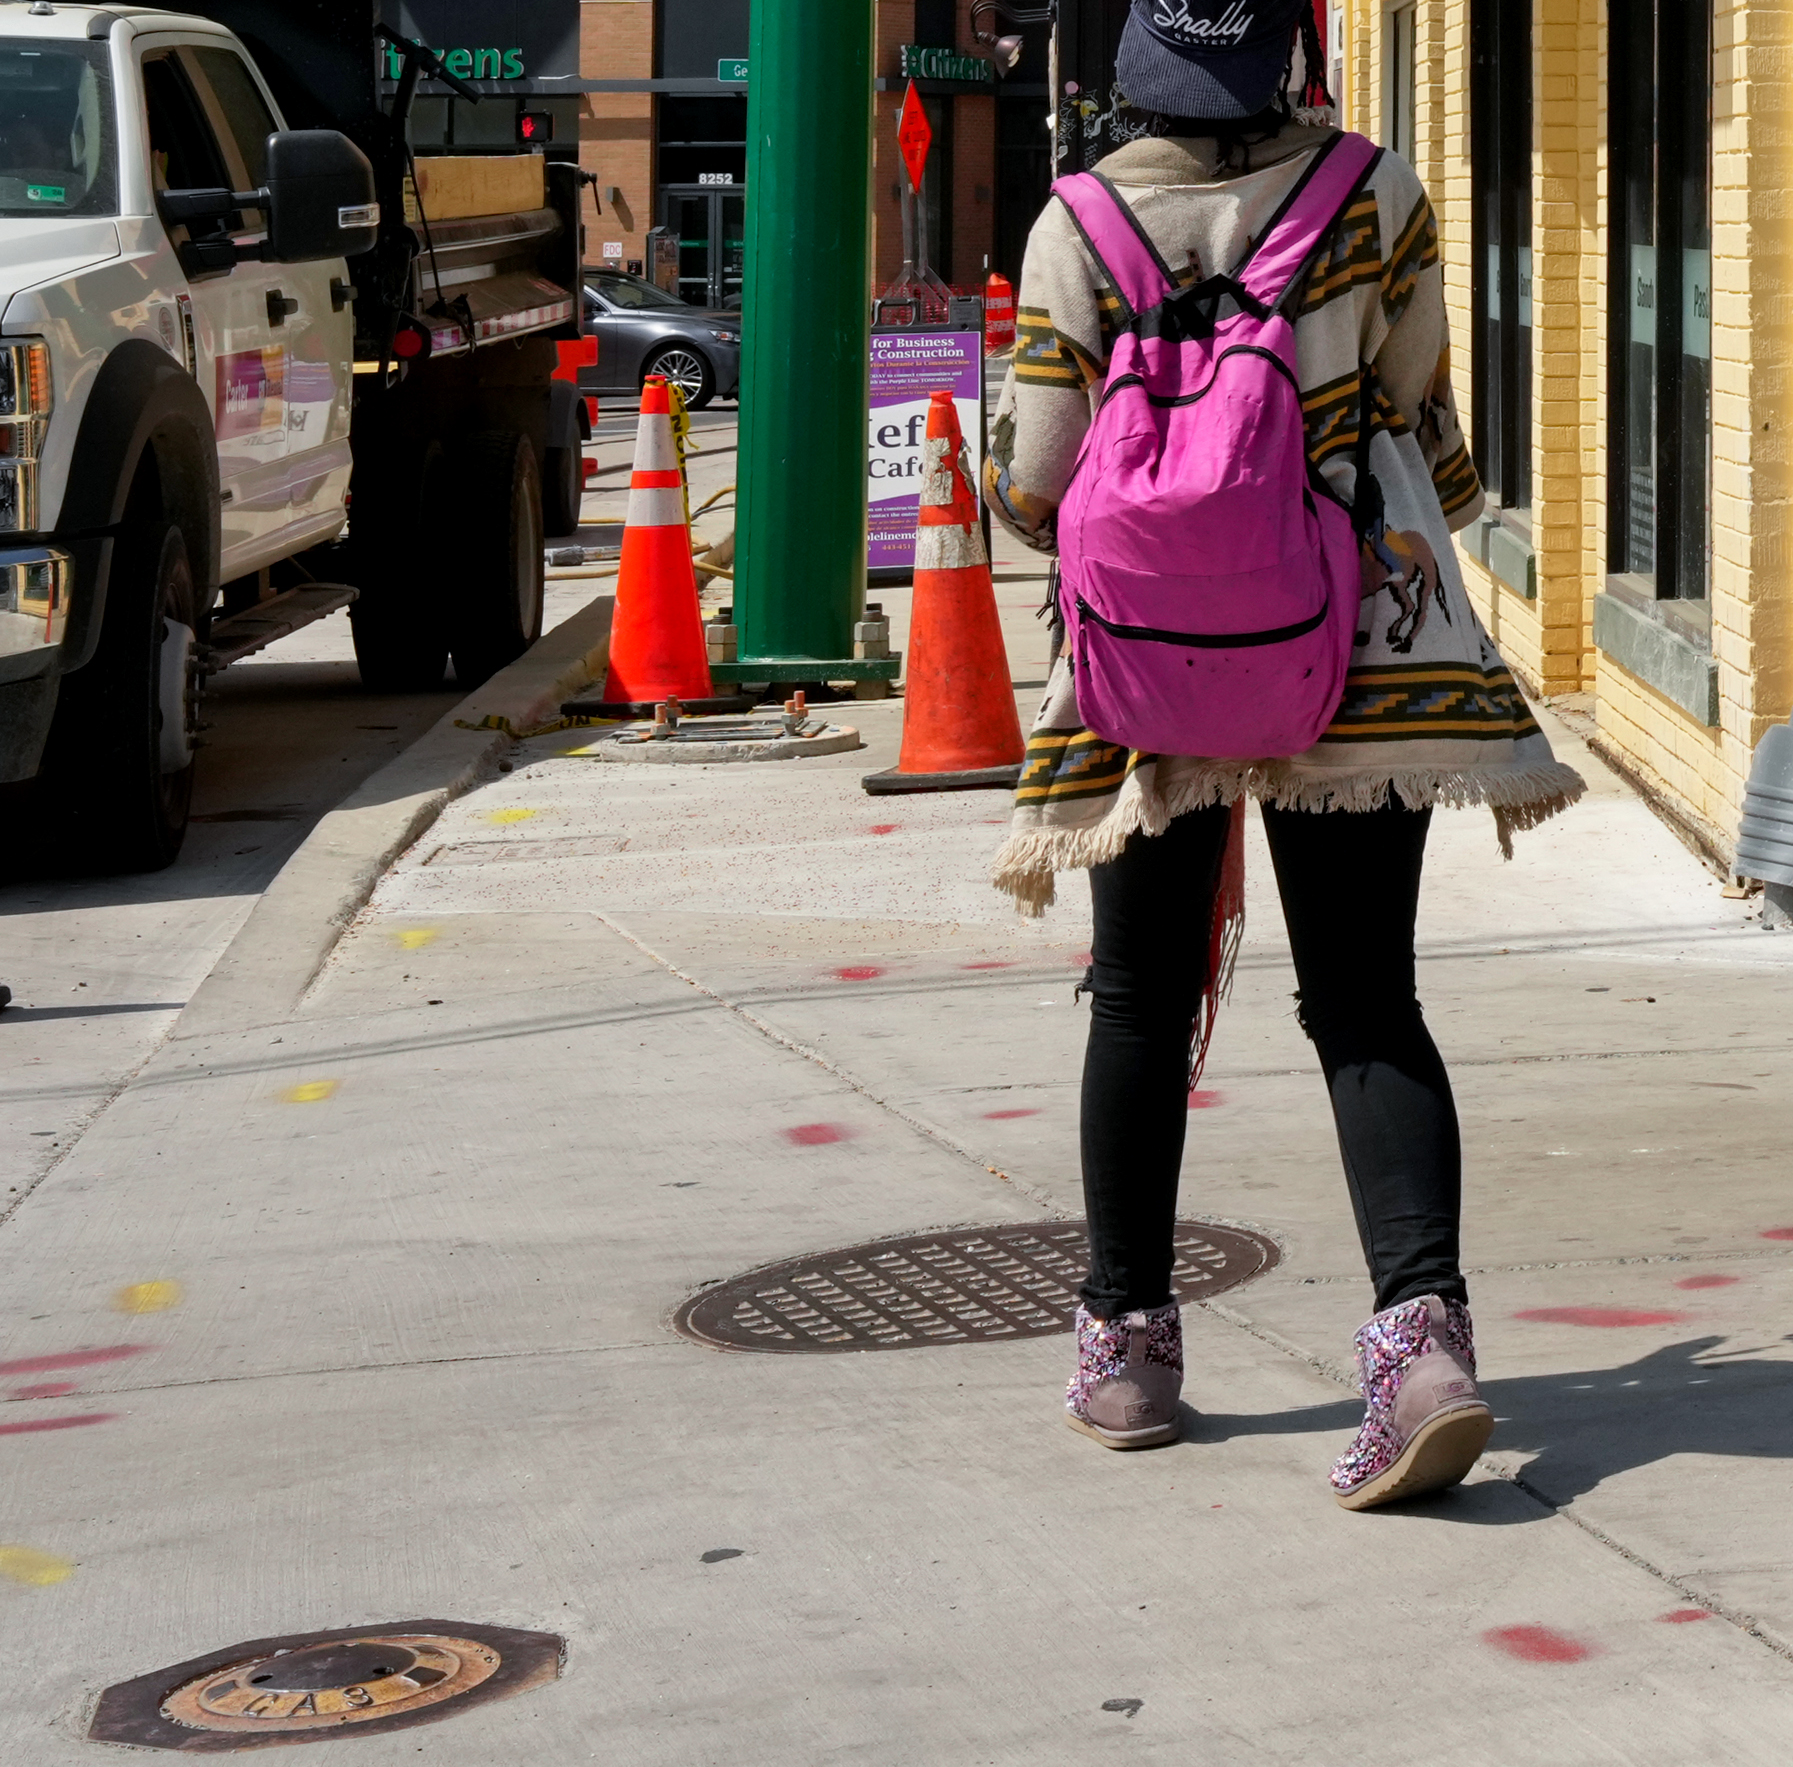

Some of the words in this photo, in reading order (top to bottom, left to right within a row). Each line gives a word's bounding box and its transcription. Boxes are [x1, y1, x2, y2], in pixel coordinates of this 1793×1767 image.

[920, 47, 992, 81] Citizens
[699, 173, 733, 185] 8252
[604, 244, 621, 256] FDC
[873, 338, 893, 349] for
[896, 337, 955, 348] Business
[877, 348, 964, 360] Construction
[242, 1686, 374, 1718] GAS
